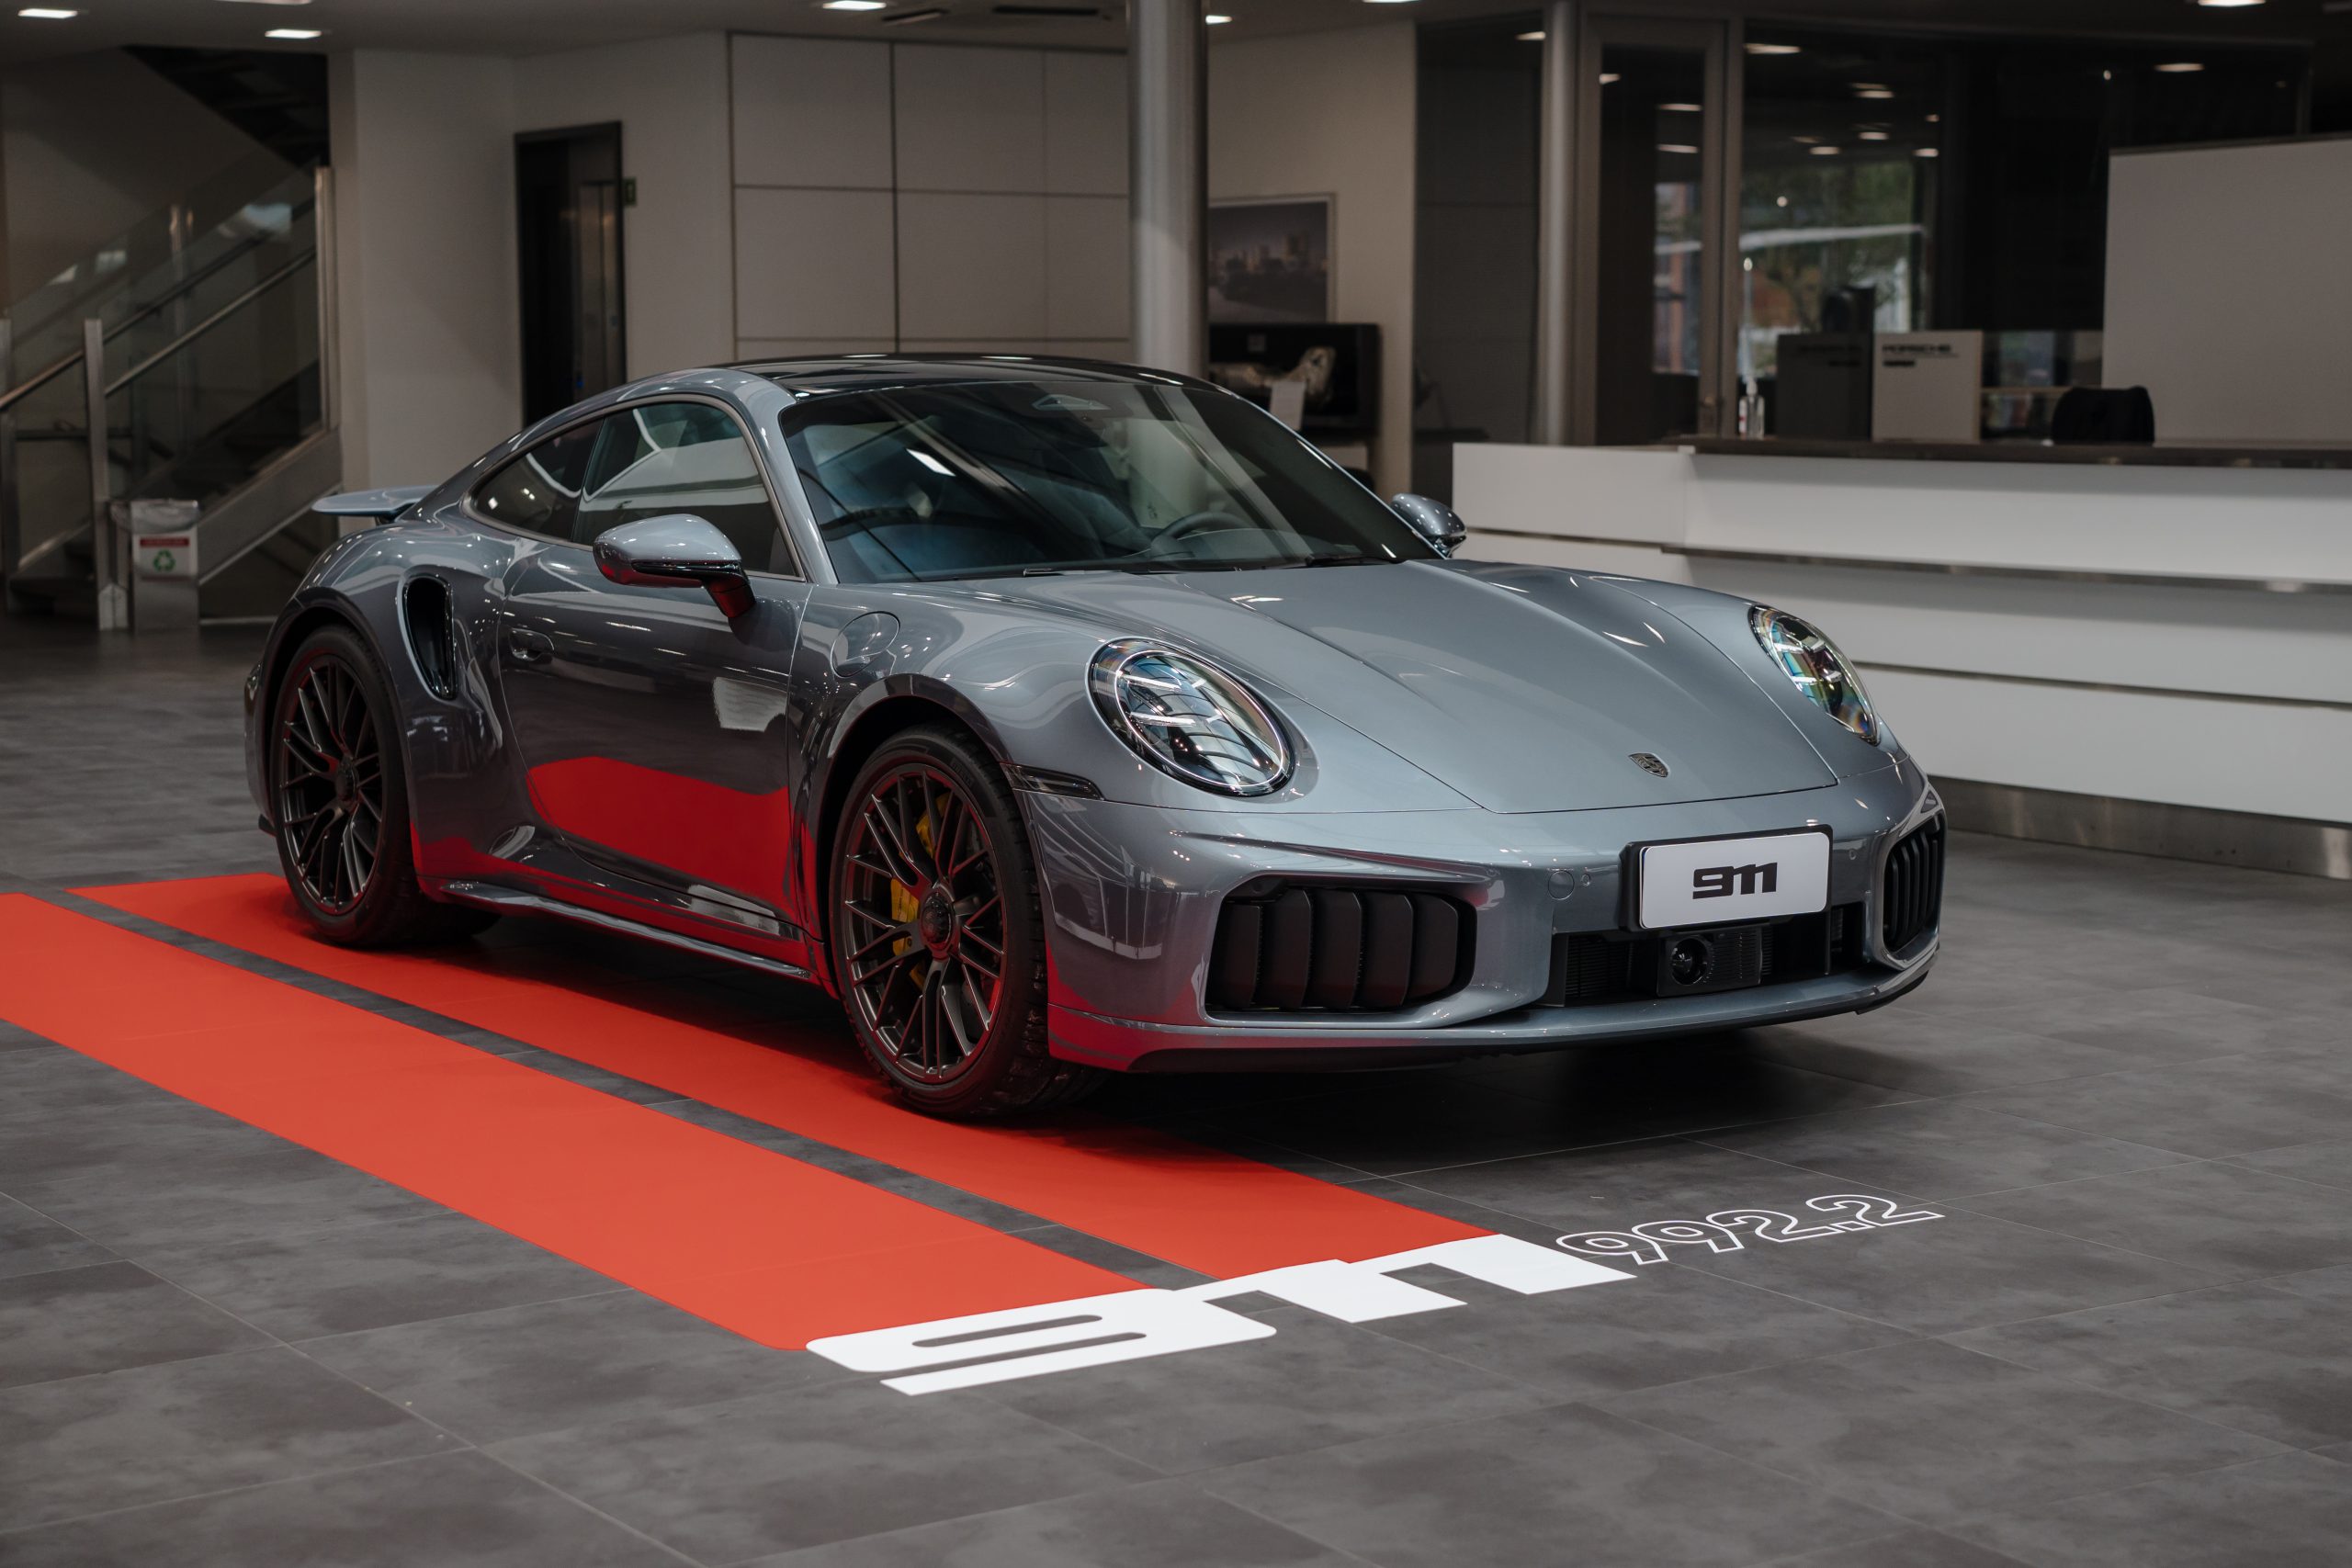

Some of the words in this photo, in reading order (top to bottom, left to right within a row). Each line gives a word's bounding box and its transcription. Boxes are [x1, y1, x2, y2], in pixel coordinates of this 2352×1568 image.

[1692, 862, 1778, 900] 911
[806, 1234, 1638, 1396] 911
[1556, 1194, 1946, 1266] 992.2
